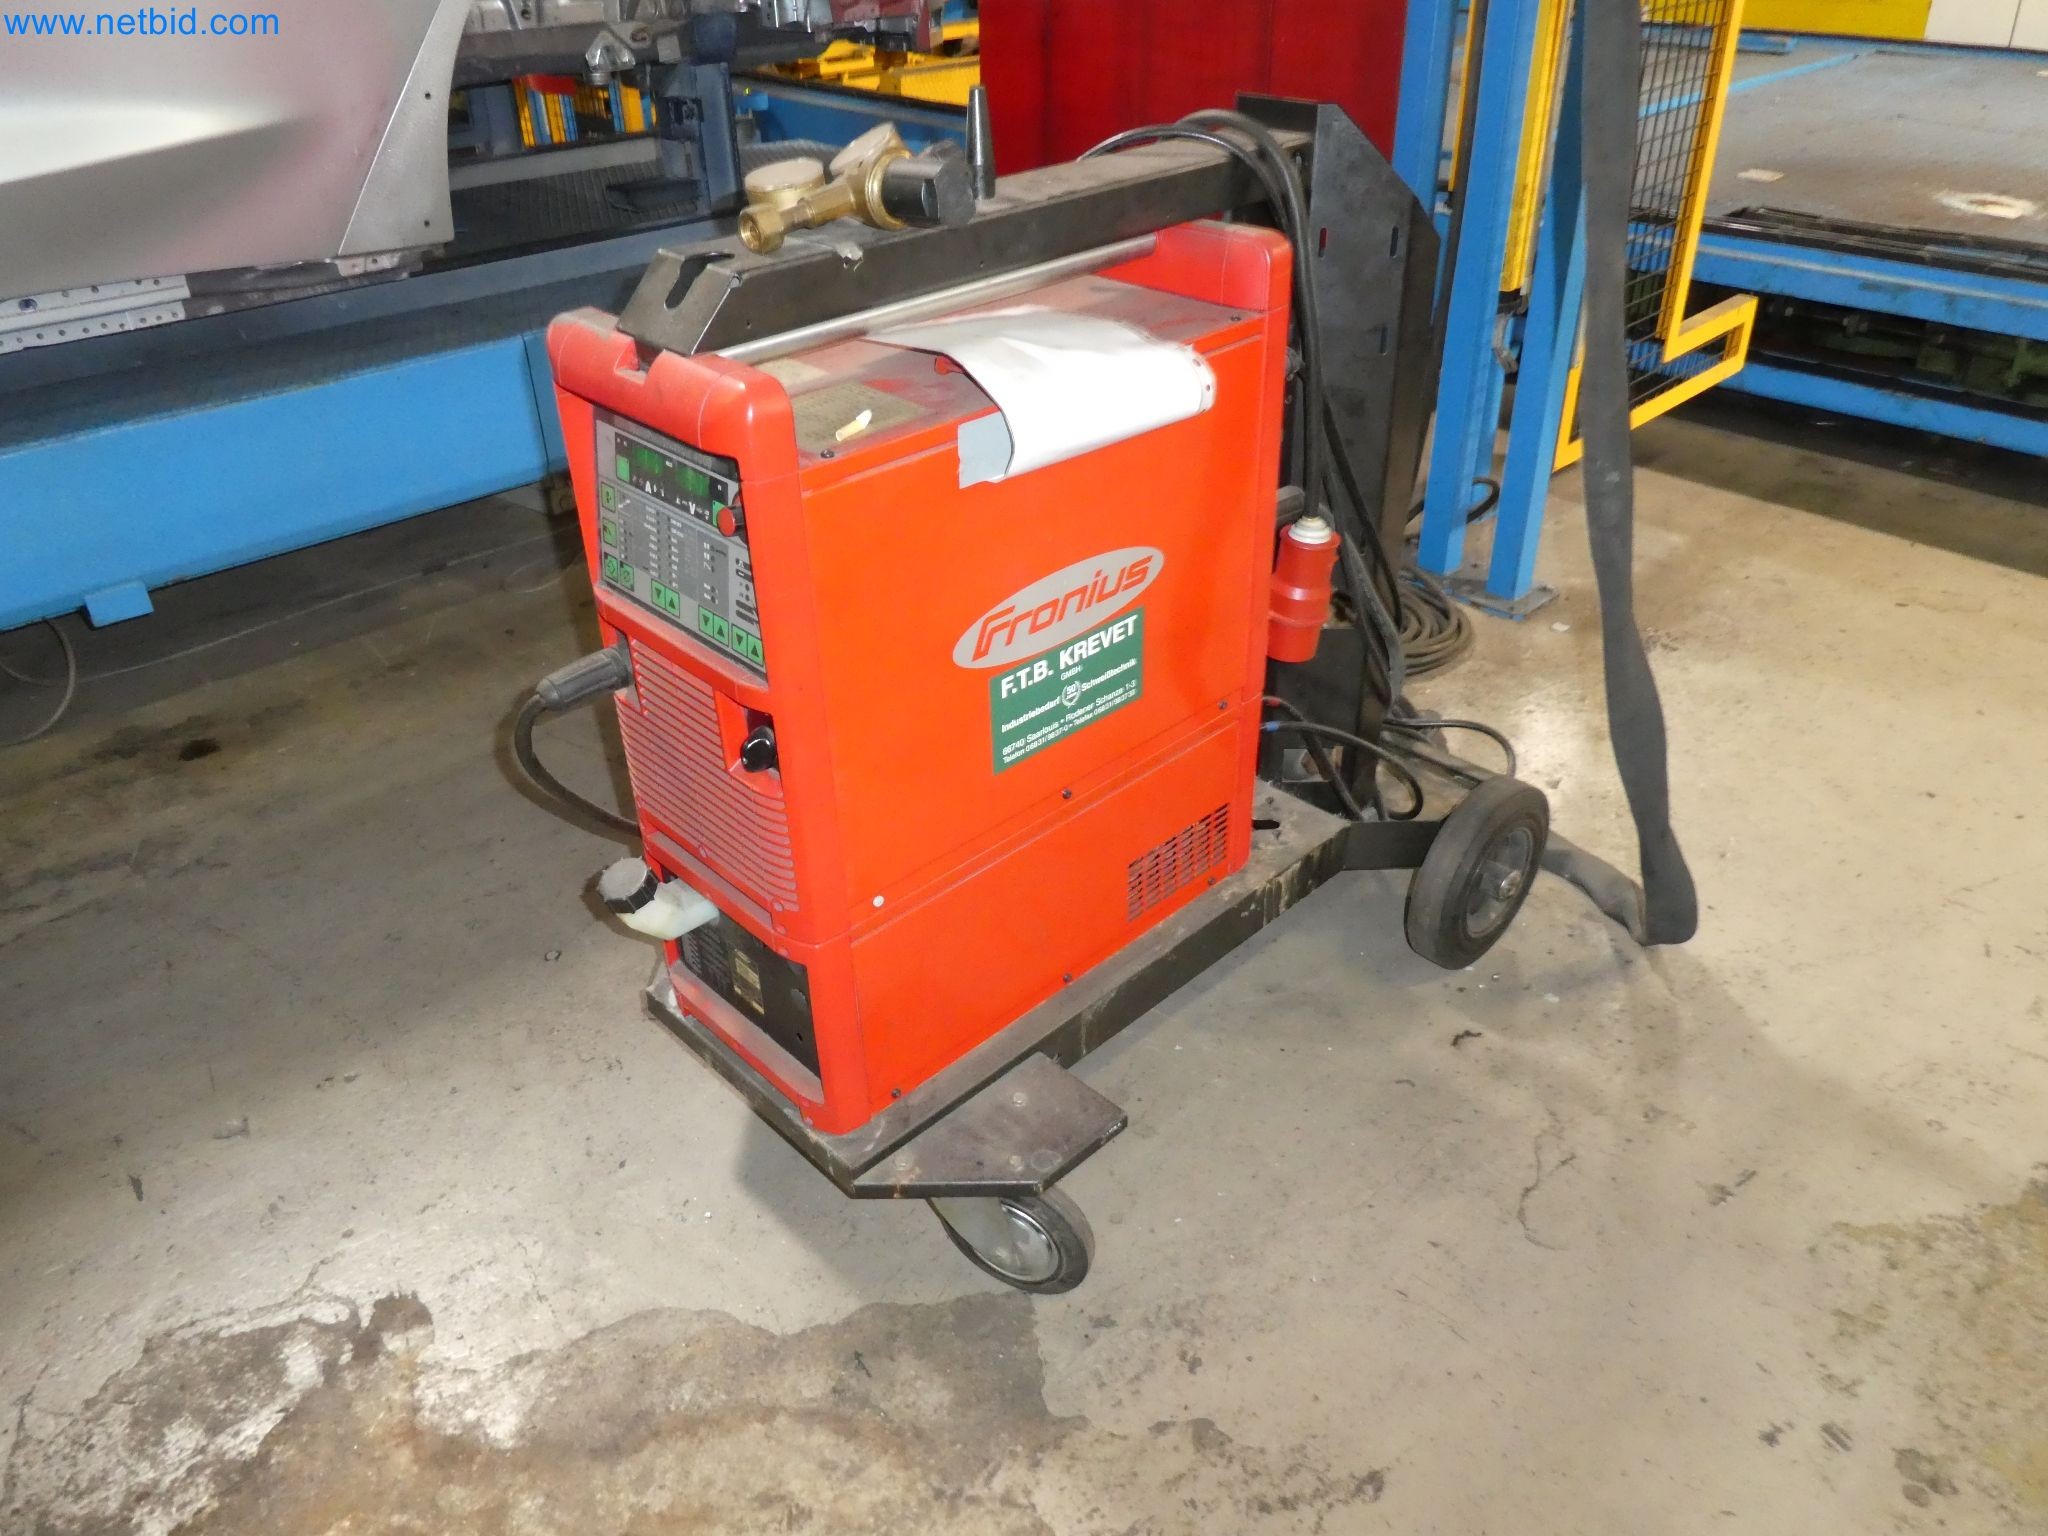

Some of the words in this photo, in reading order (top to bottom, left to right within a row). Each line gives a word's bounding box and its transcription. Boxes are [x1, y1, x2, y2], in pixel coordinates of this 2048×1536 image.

[972, 555, 1153, 662] Fronius
[1001, 659, 1054, 699] F.T.B.
[1059, 614, 1138, 671] KREVET
[1001, 696, 1062, 733] Industriebedarf
[1081, 657, 1137, 692] Schweißtechnik
[1026, 721, 1059, 743] Saarlouis
